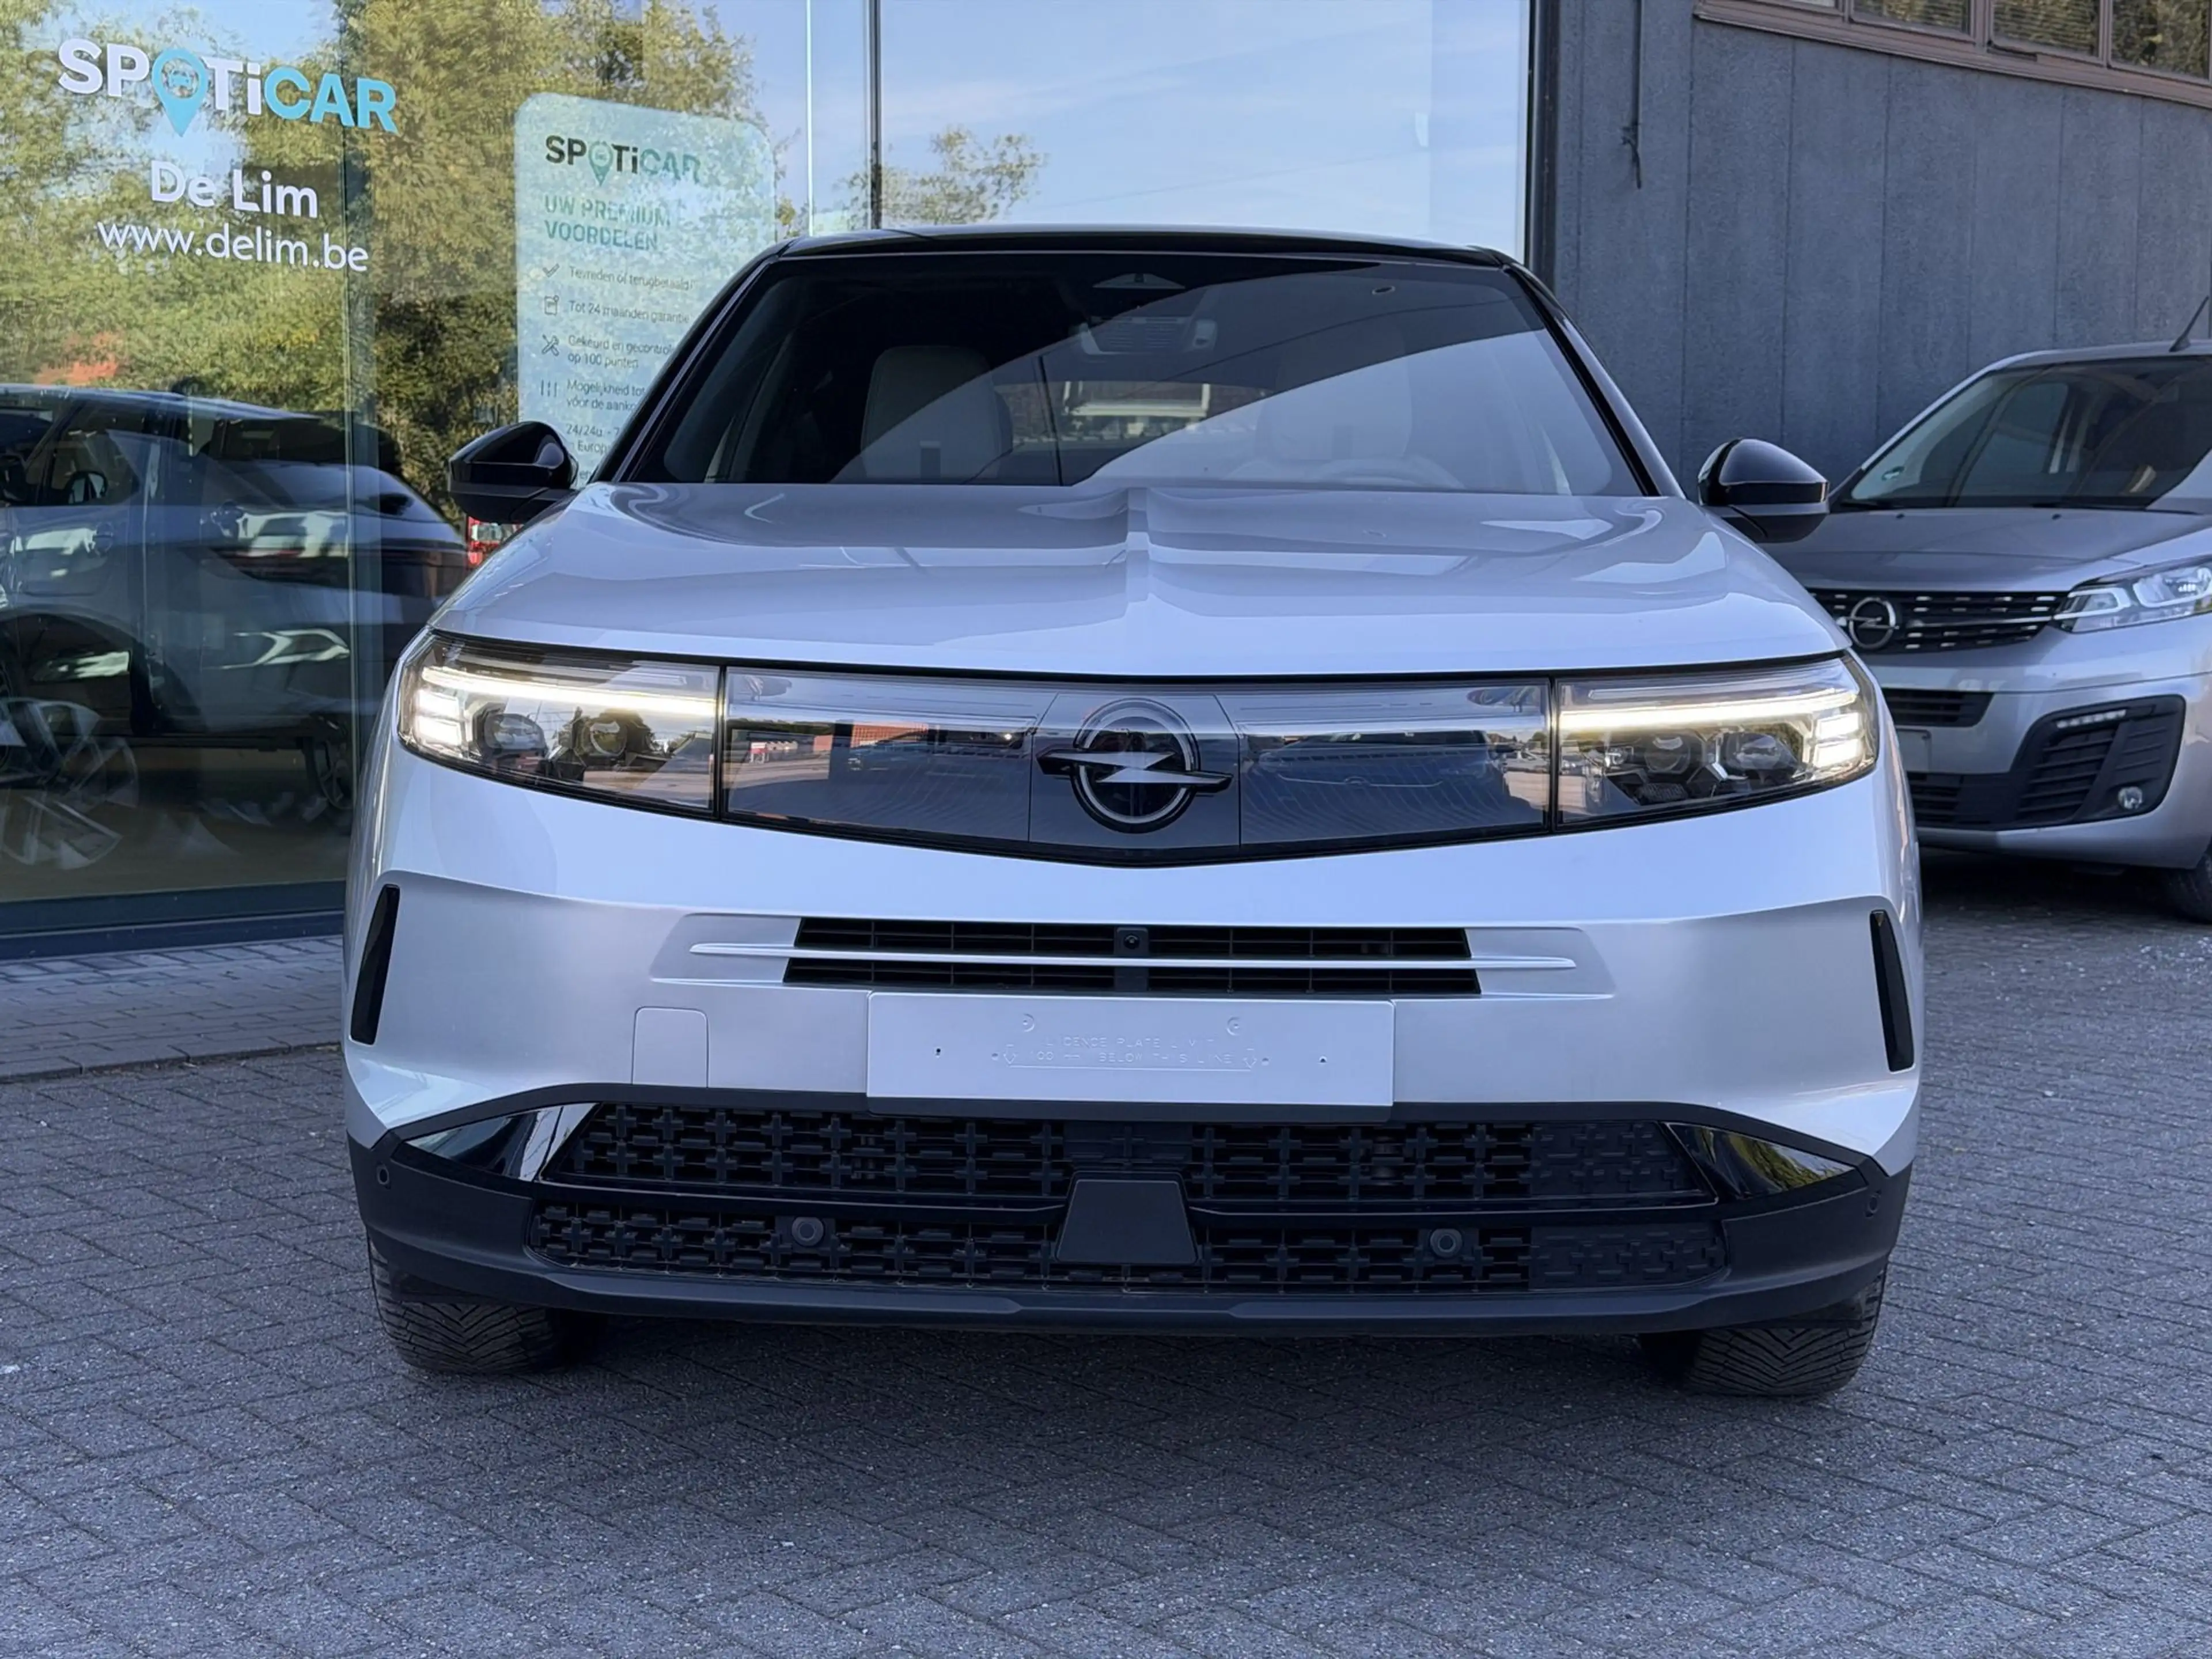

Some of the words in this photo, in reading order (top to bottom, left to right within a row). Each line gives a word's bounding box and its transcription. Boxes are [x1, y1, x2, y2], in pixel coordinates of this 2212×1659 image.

[151, 161, 217, 208] De
[233, 170, 318, 219] Lim
[545, 195, 575, 216] UW
[581, 199, 671, 226] PREMIUM
[544, 219, 658, 251] VOORDELEN
[97, 222, 369, 272] www.delim.be
[569, 300, 586, 313] Tot
[588, 303, 601, 315] 24
[567, 353, 581, 365] op
[584, 354, 602, 365] 100
[591, 398, 605, 410] de
[578, 440, 609, 455] Europ
[1043, 1036, 1108, 1049] LCENCE
